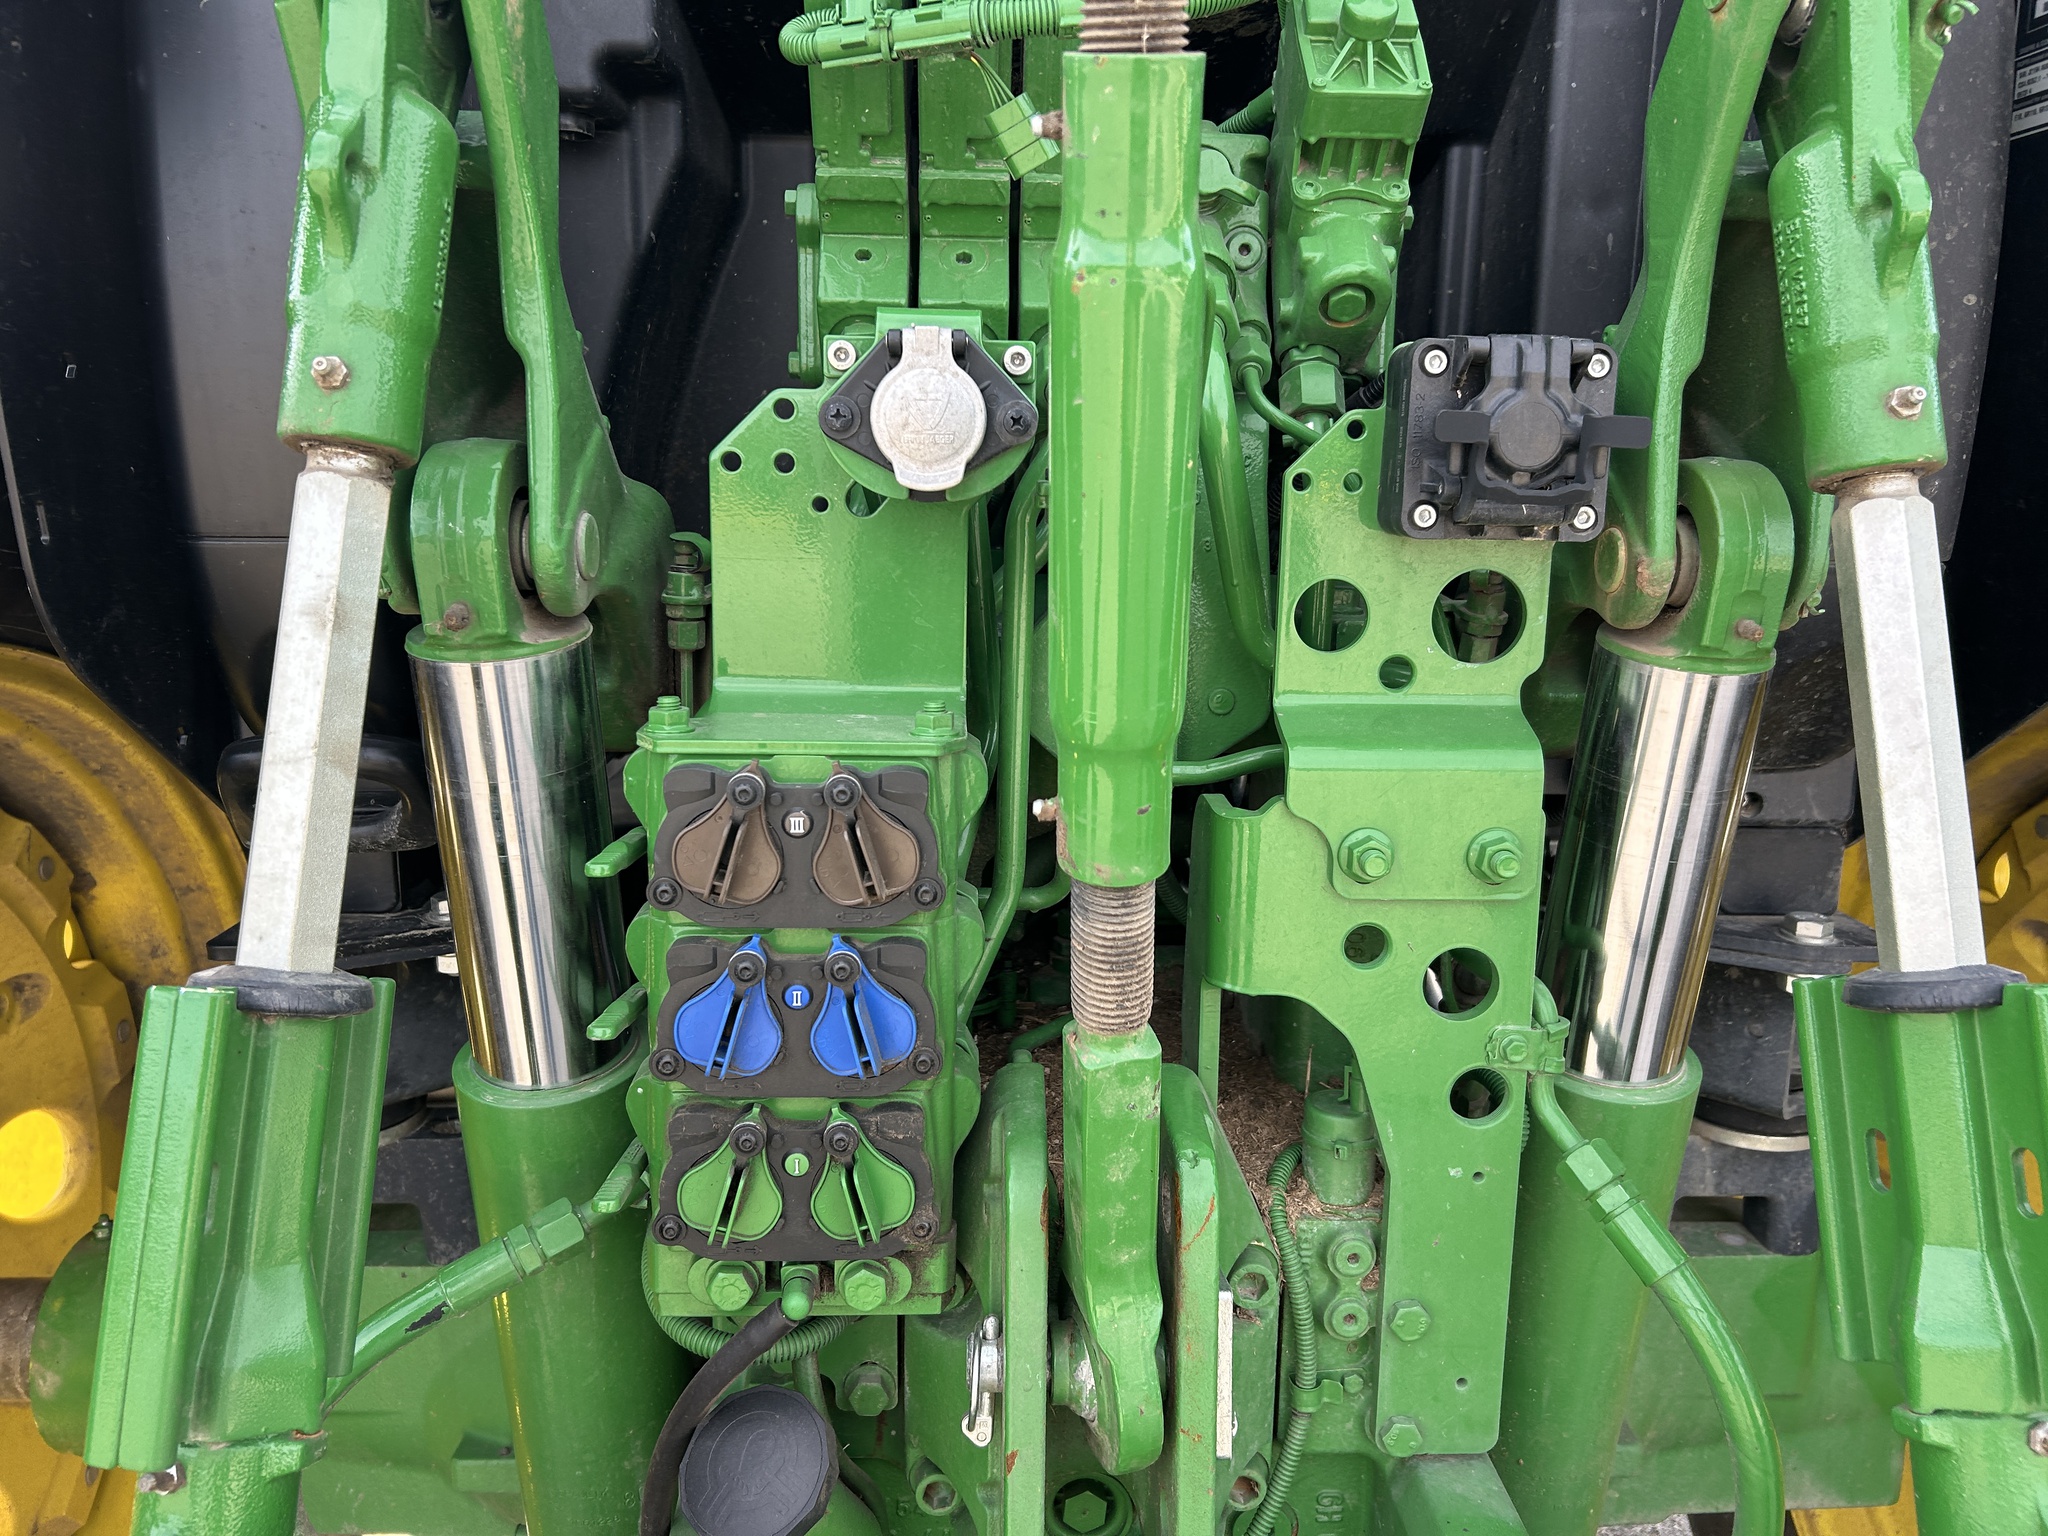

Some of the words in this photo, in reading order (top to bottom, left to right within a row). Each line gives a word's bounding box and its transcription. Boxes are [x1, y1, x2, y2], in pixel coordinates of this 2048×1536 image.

[1412, 393, 1426, 439] 11783-2
[1410, 448, 1422, 469] ISO
[789, 817, 805, 834] III
[792, 990, 802, 1007] II
[794, 1159, 800, 1174] I
